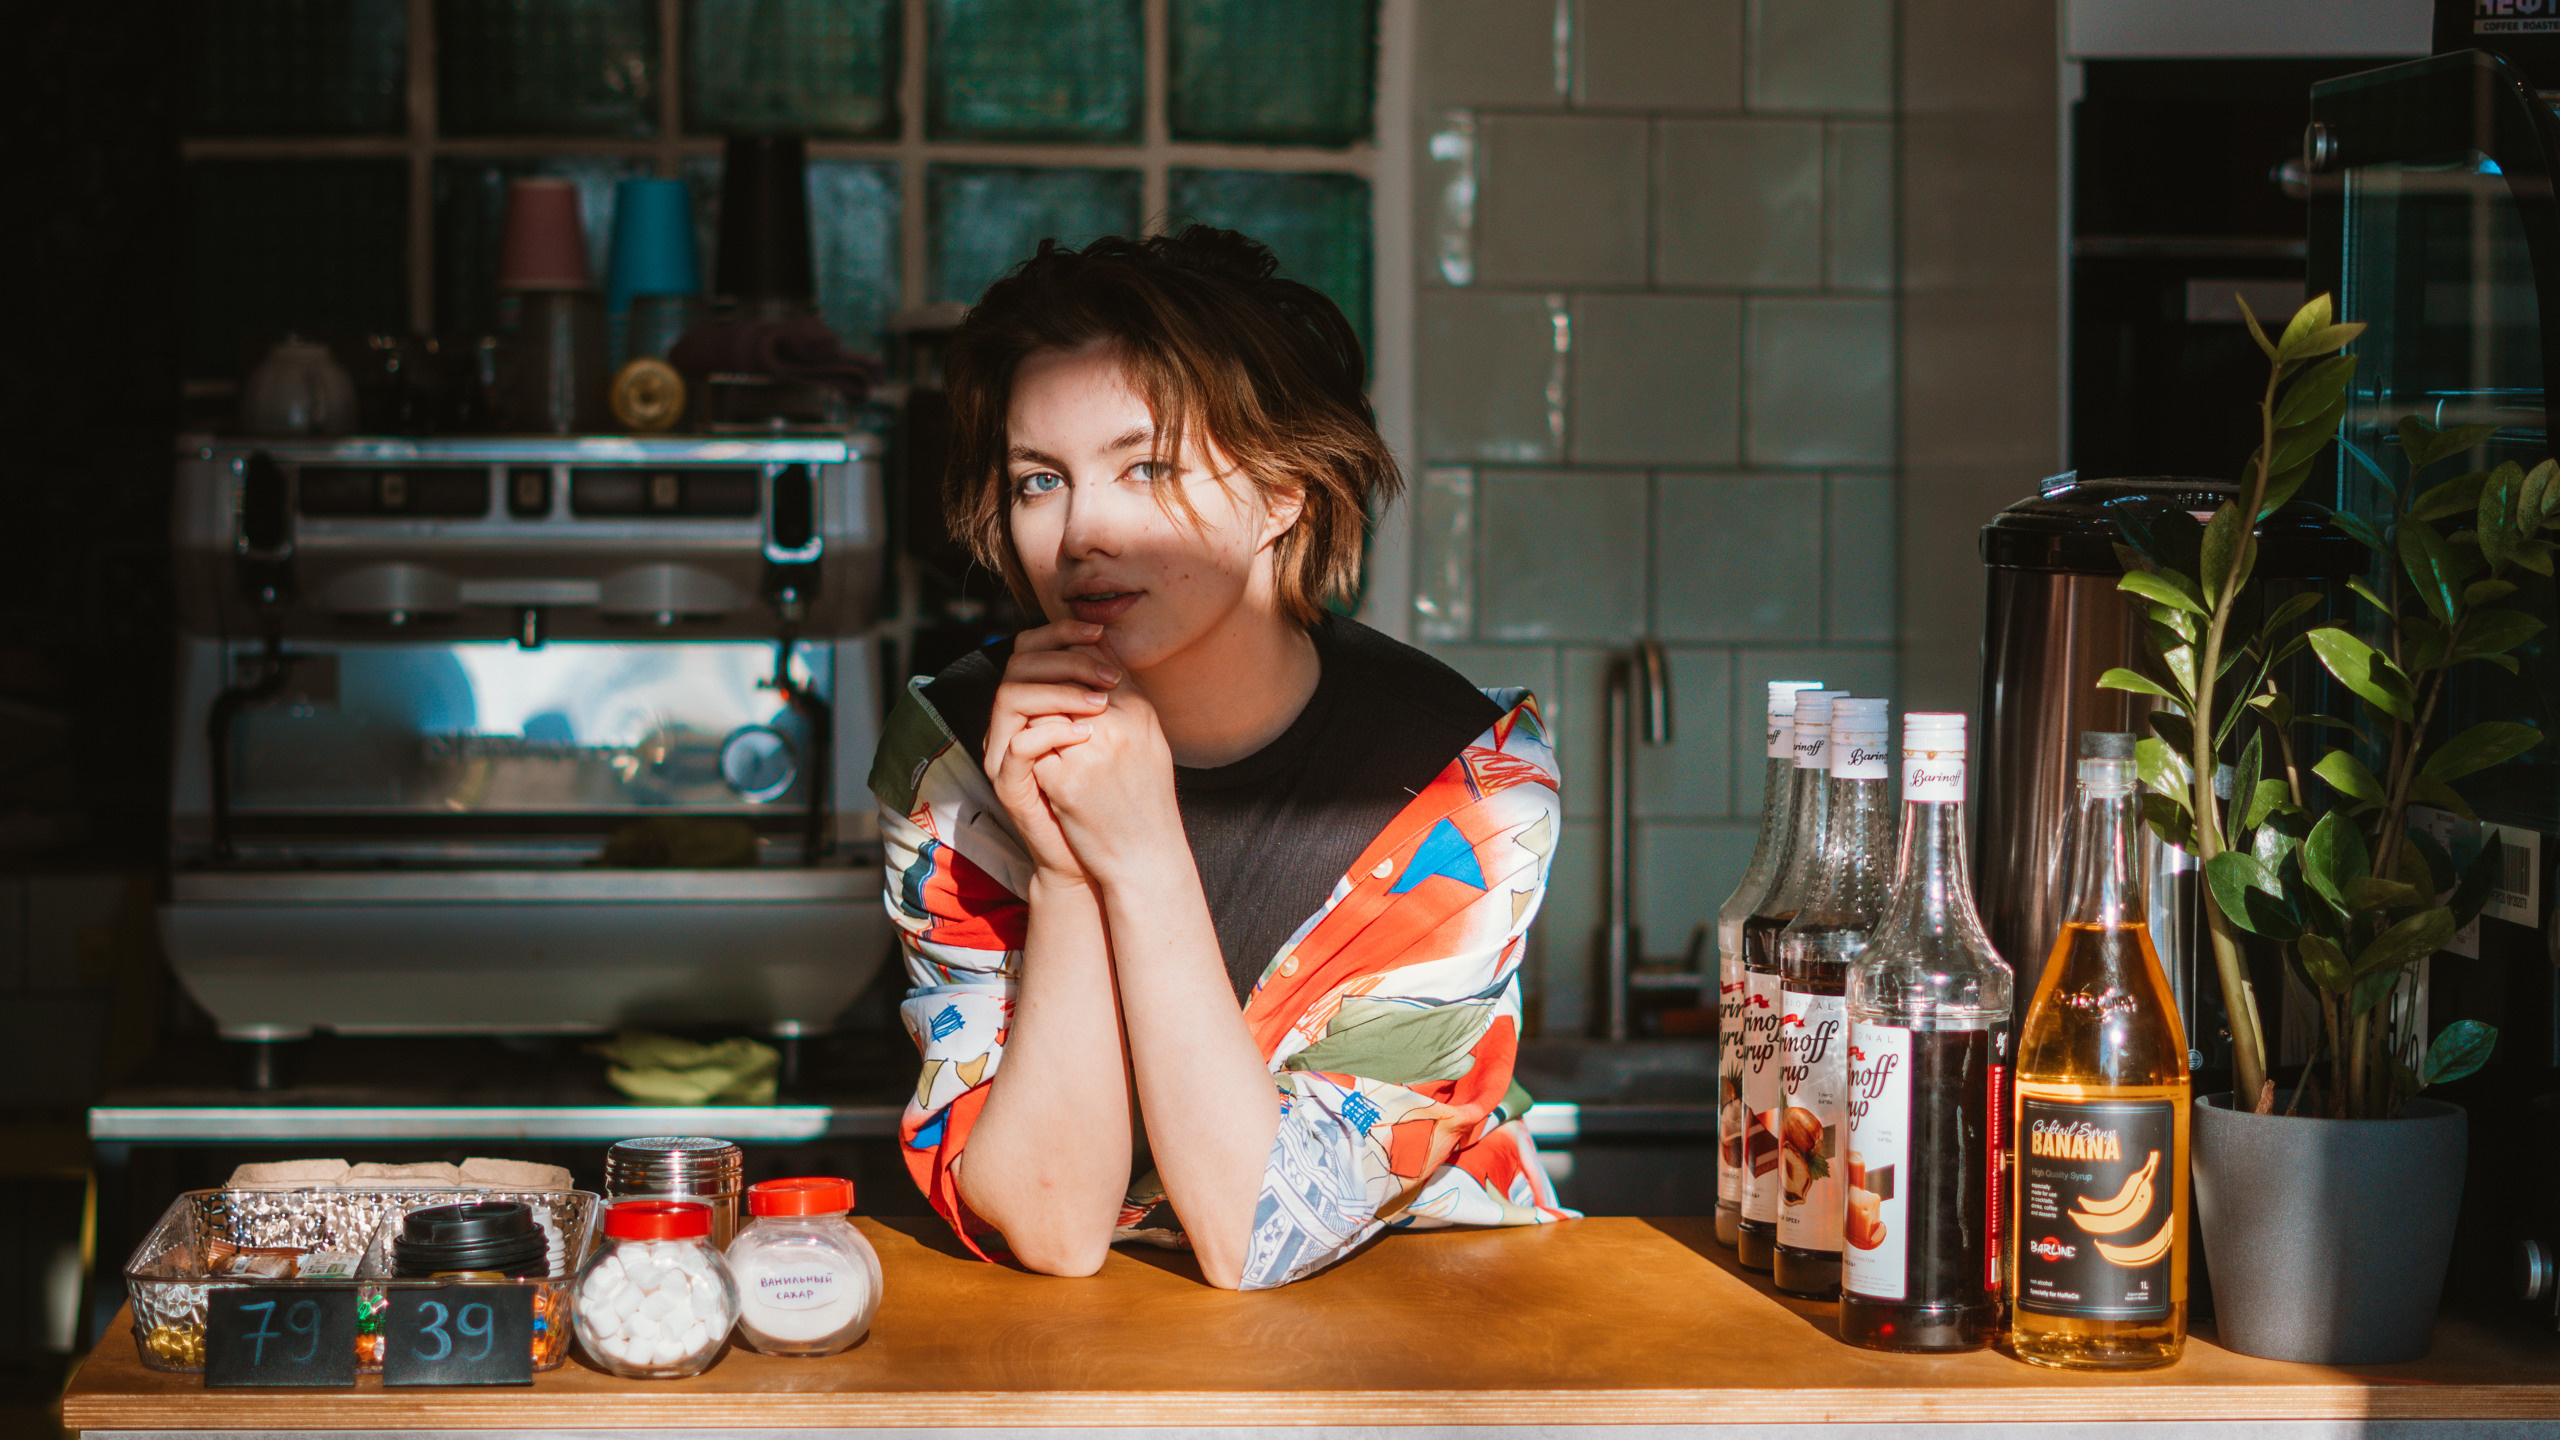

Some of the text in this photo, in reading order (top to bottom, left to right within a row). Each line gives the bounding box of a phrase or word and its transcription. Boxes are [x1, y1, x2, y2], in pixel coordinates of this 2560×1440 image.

[2484, 22, 2519, 31] COFFEE
[1910, 768, 1962, 787] Barinoff
[2032, 1119, 2118, 1145] Cocktail Syrup
[2031, 1132, 2120, 1160] BANANA
[2032, 1168, 2093, 1182] High Quality Syrup
[2031, 1183, 2051, 1191] especially
[2039, 1211, 2057, 1219] desserts
[760, 1272, 834, 1288] ВАНИЛЬНЫЙ
[2140, 1281, 2149, 1290] 1L
[776, 1290, 815, 1300] САХАР
[240, 1299, 322, 1366] 79
[412, 1300, 494, 1362] 39
